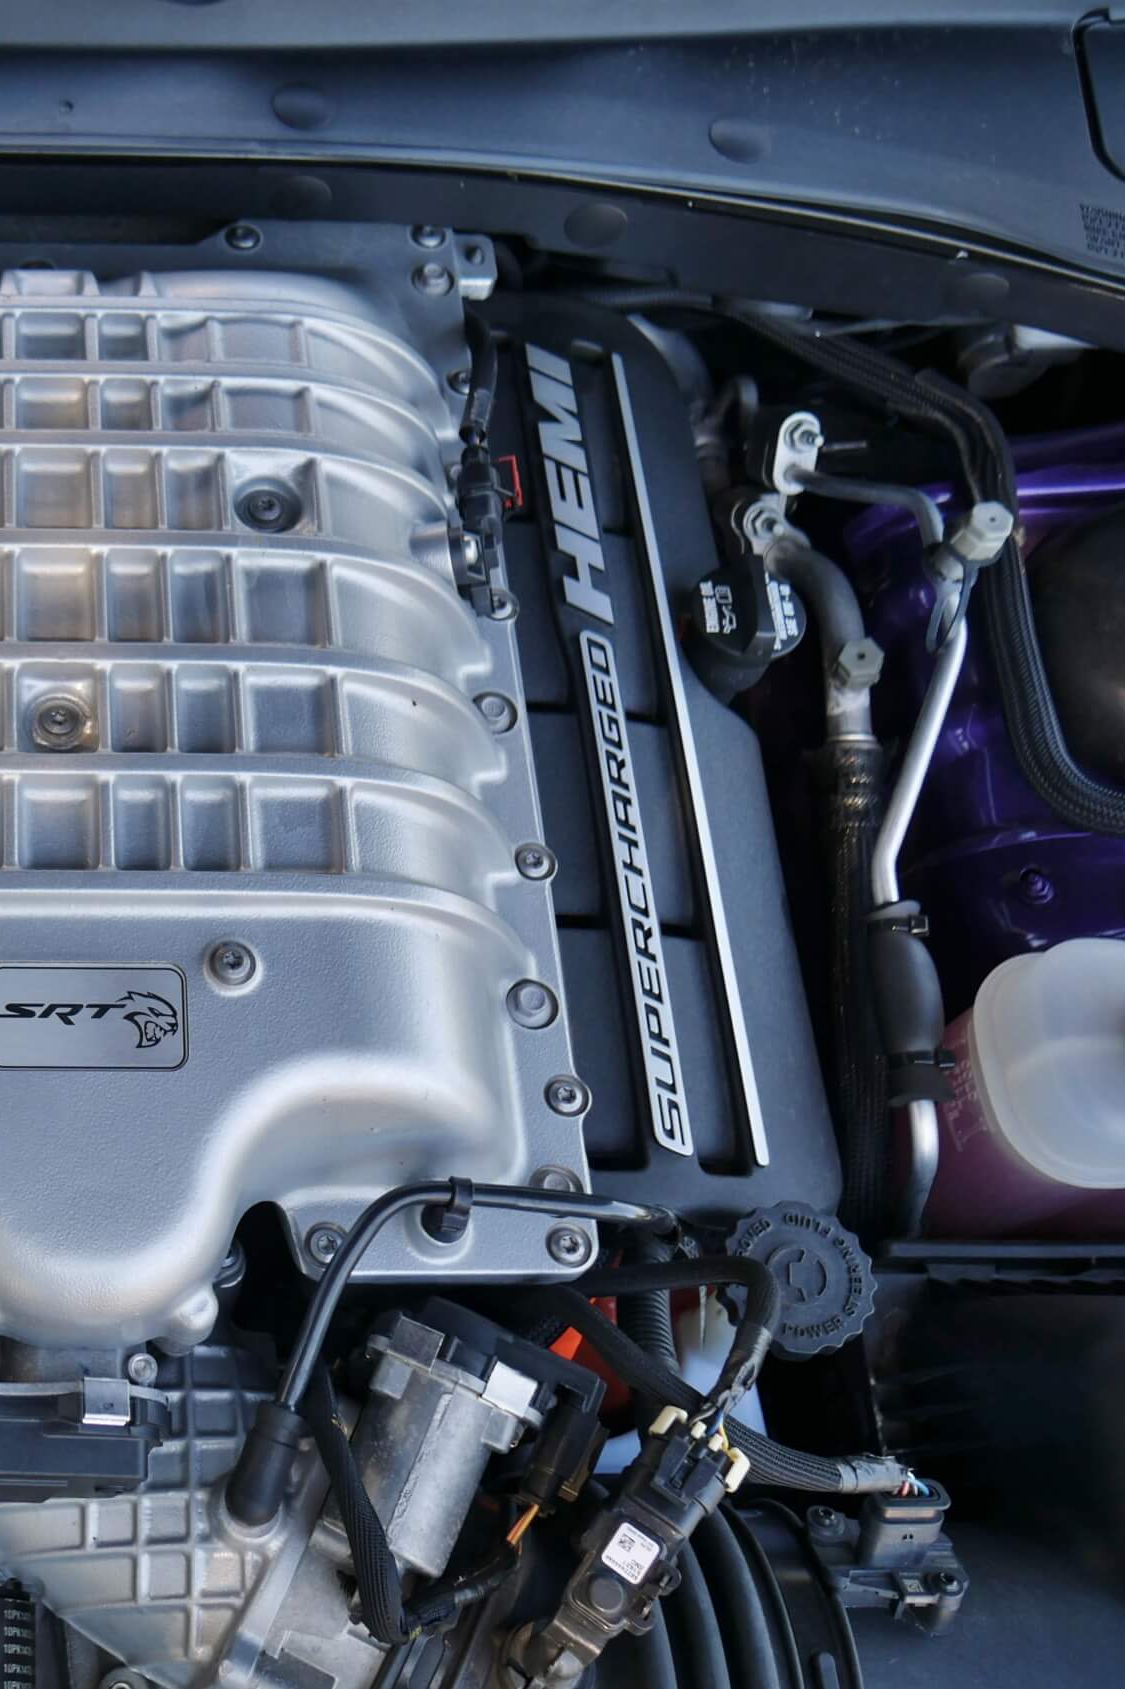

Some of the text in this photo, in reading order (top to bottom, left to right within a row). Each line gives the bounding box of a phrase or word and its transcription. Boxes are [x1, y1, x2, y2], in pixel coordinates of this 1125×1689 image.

[525, 343, 685, 1148] SUPERCHARGED HEMI
[781, 1314, 843, 1338] POWER
